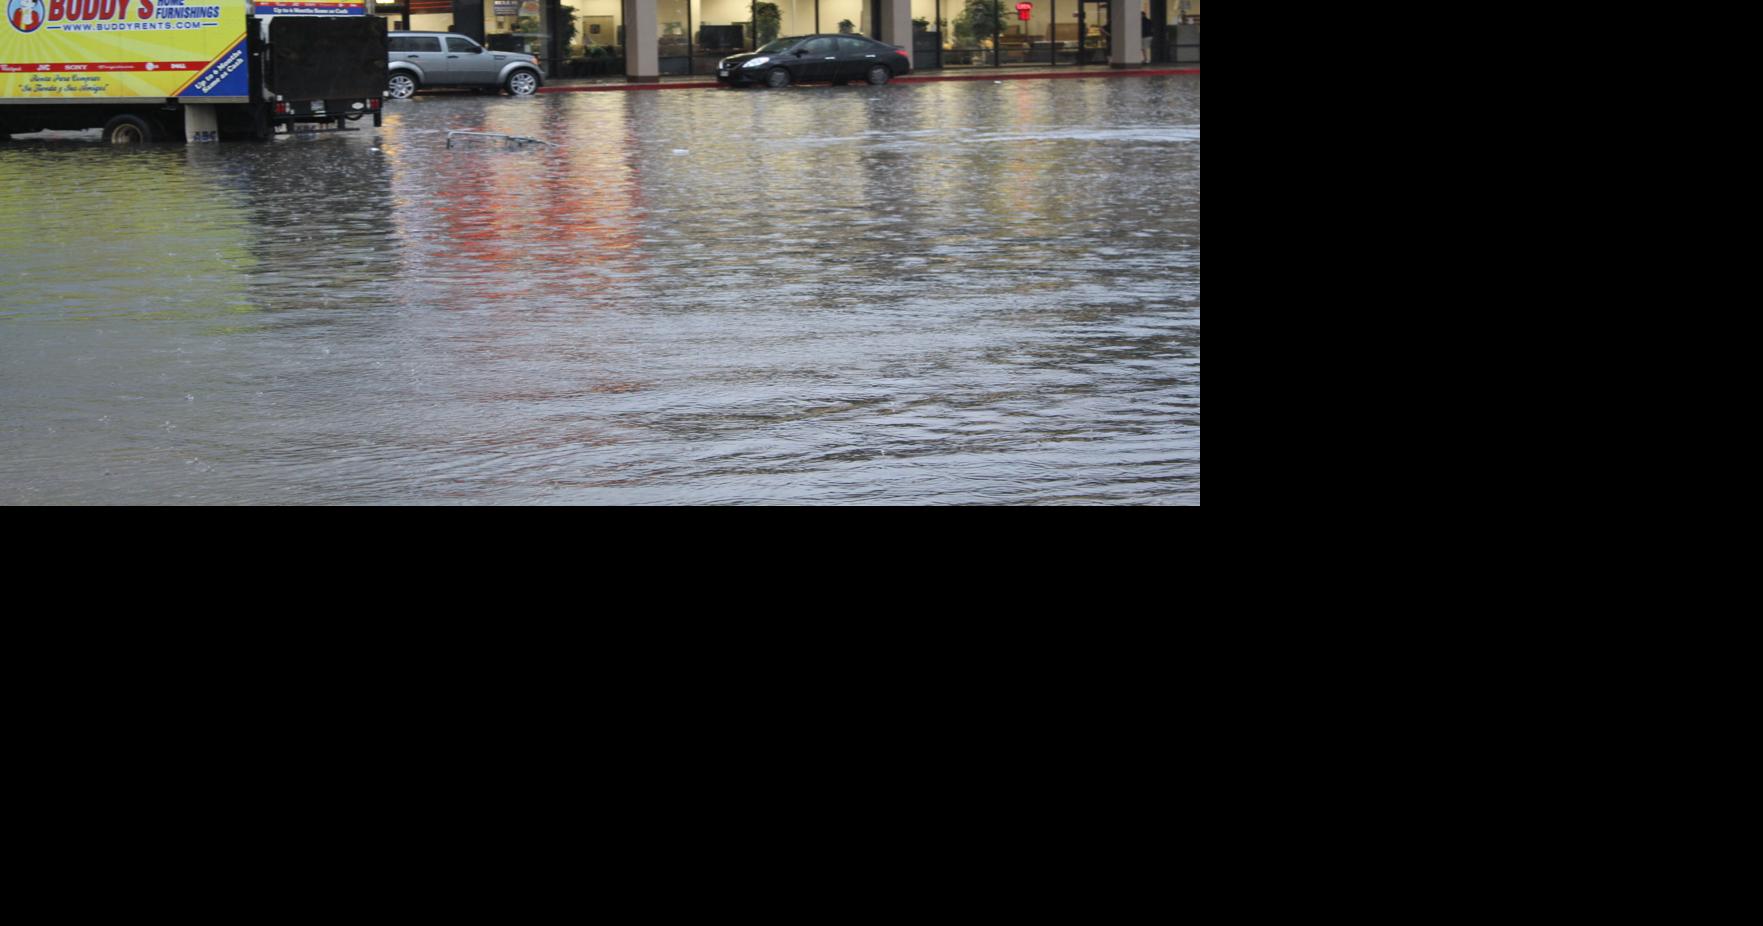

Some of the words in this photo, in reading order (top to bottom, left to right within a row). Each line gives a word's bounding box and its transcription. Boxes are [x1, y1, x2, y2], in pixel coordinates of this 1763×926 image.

[48, 0, 153, 21] BUDDYS
[155, 6, 220, 19] FURNISHINGS
[63, 22, 200, 31] WWW.BUDDYRENTS.COM
[226, 58, 244, 72] Cash
[194, 80, 206, 90] Up
